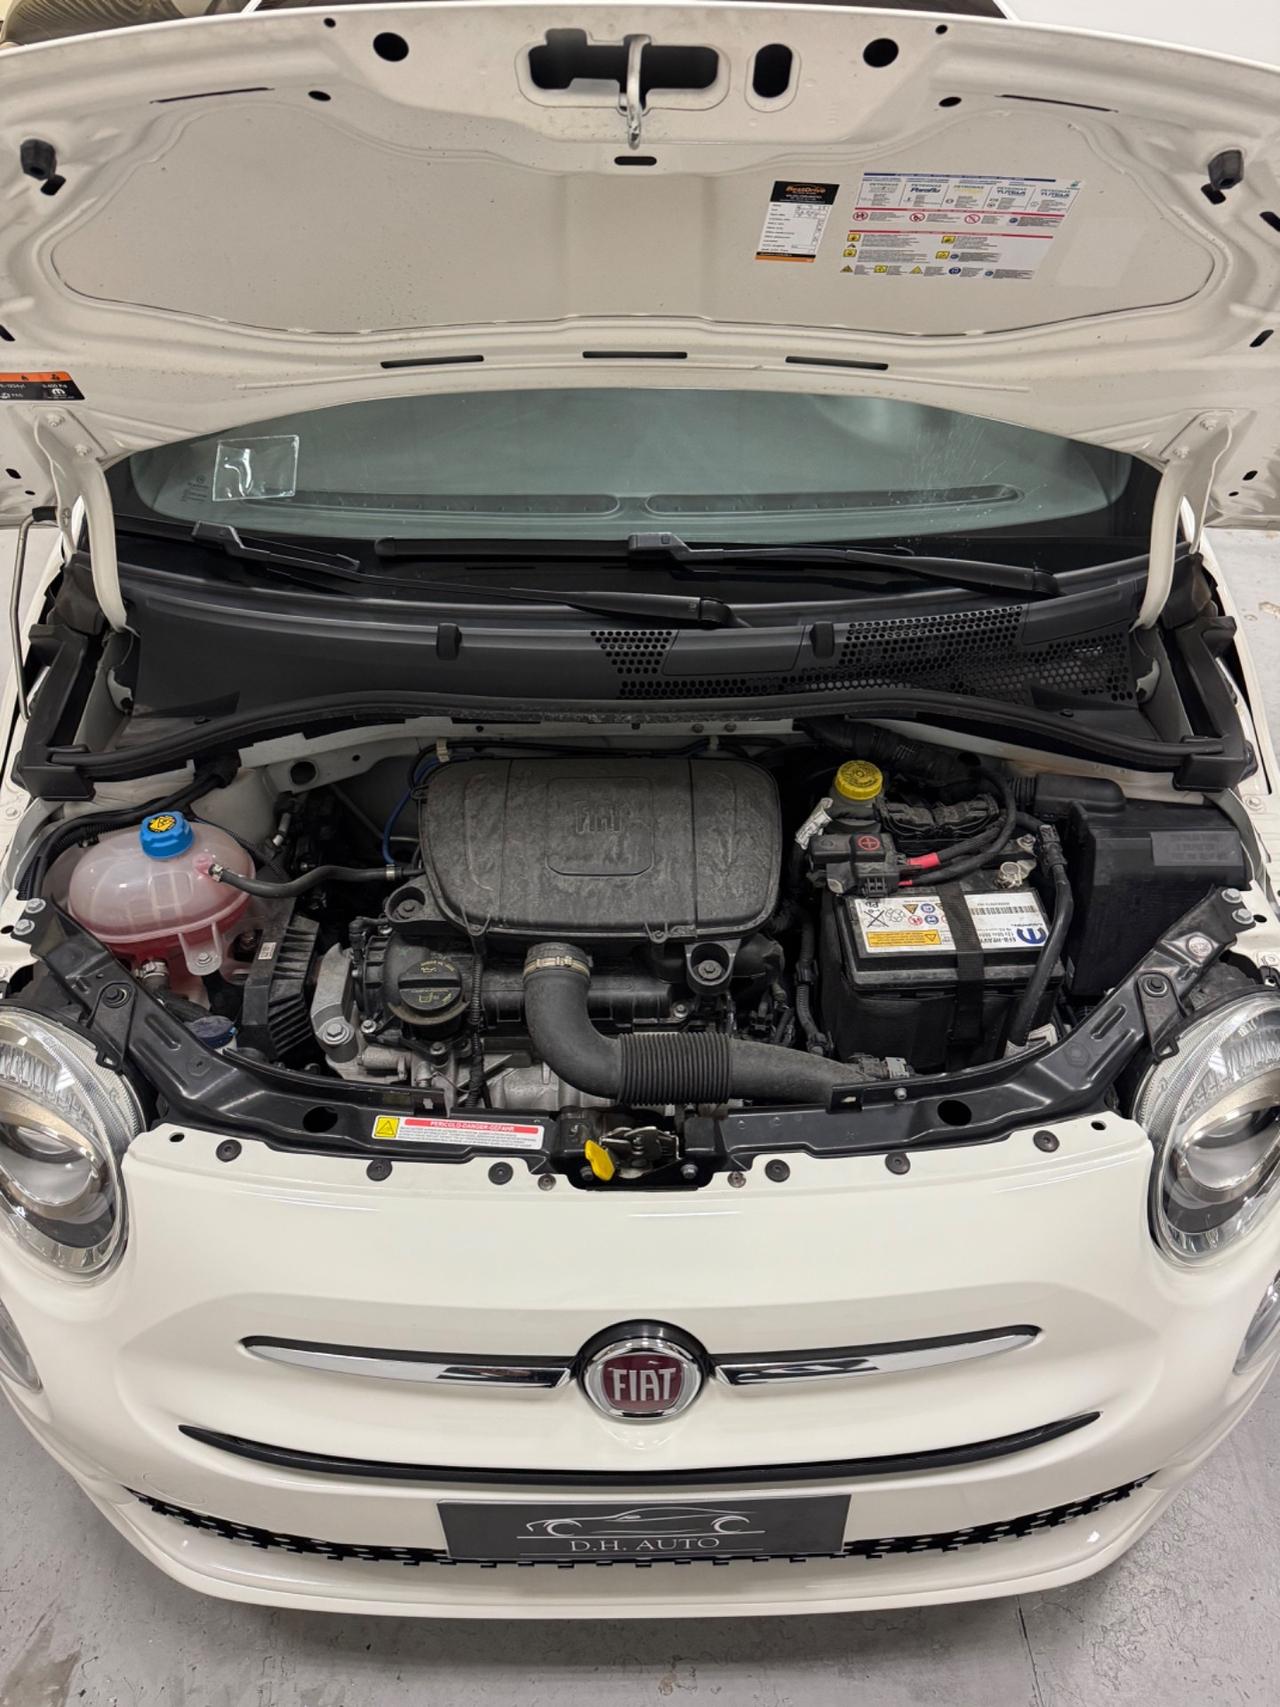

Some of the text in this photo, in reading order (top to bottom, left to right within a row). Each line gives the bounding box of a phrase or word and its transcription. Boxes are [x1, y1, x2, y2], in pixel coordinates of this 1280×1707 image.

[607, 1367, 677, 1401] FIAT
[570, 1537, 720, 1552] D.H. AUTO
